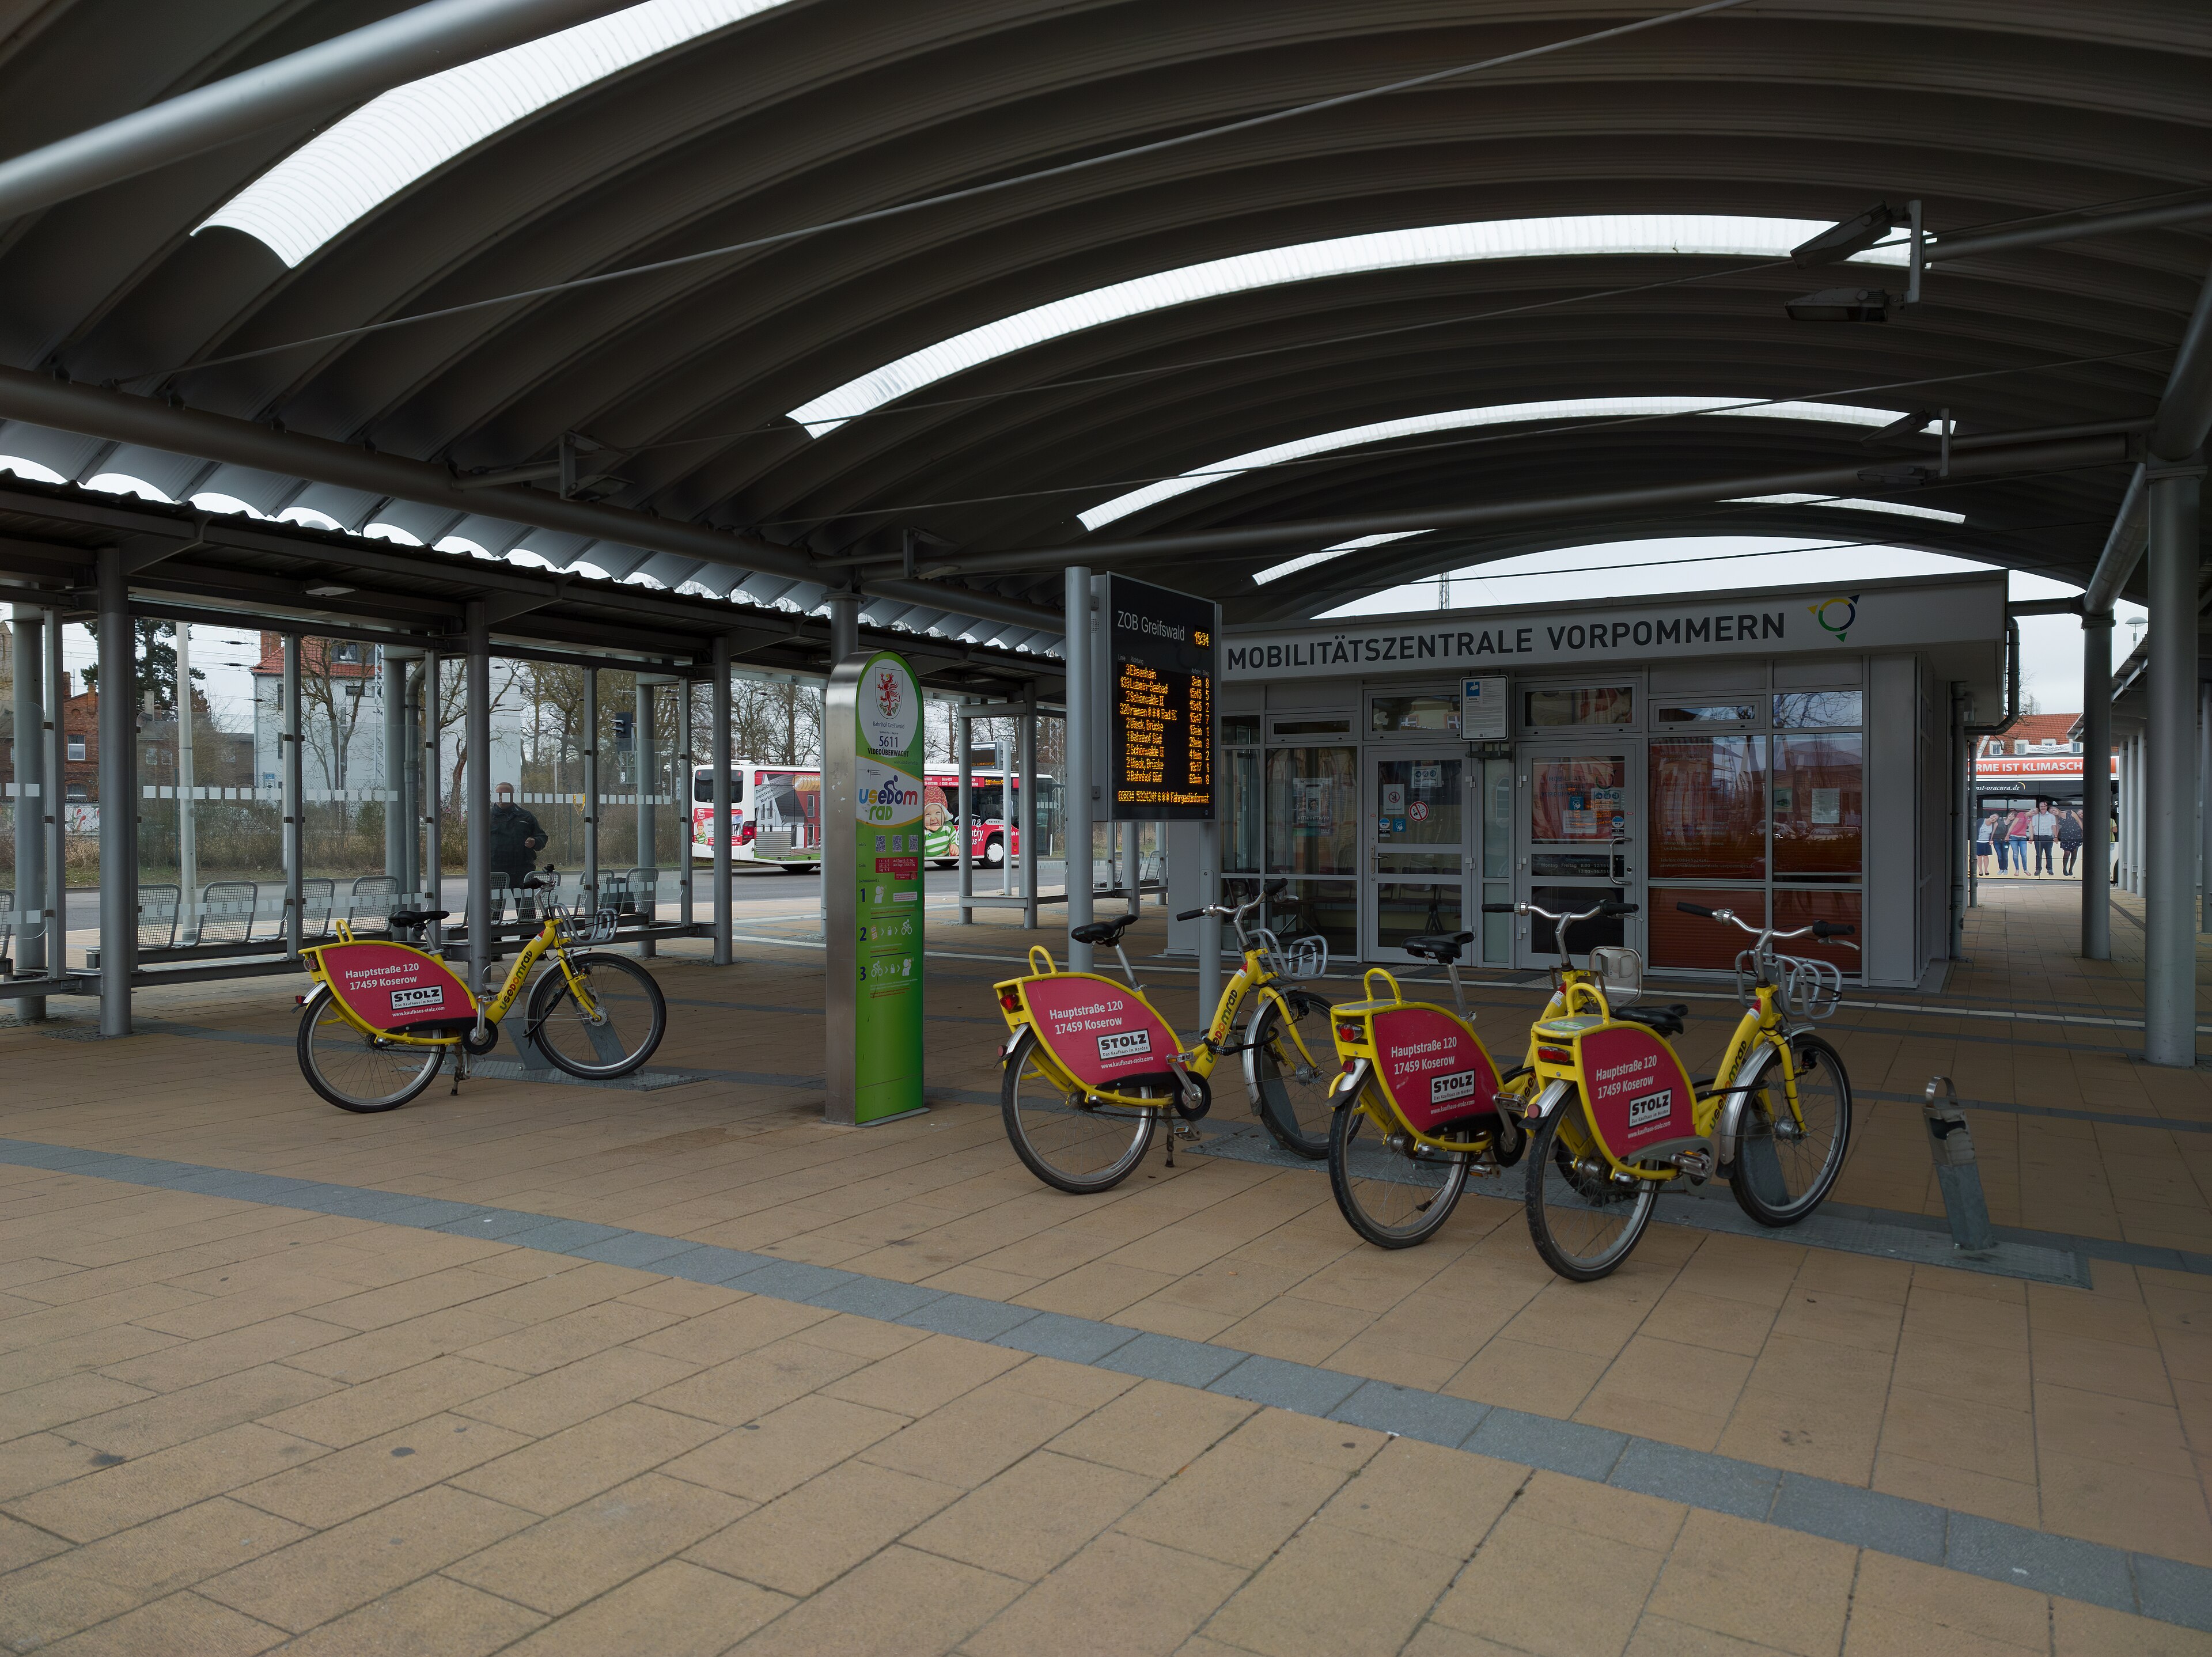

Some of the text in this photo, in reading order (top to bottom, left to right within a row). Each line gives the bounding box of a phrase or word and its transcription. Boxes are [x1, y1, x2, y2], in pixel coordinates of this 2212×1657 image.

[1118, 611, 1184, 641] ZOB Greifswald
[1227, 612, 1785, 671] MOBILITÄTSZENTRALE VORPOMMERN
[1130, 657, 1143, 665] Richtung
[878, 735, 899, 748] 5611
[868, 747, 910, 757] VIDEOÜBERWACHT
[1976, 761, 2082, 772] RME IST KLIMASCH
[860, 888, 865, 903] 1
[859, 927, 867, 942] 2
[345, 963, 419, 979] Hauptstraße 120
[859, 966, 866, 981] 3
[350, 976, 417, 990] 17459 Koserow
[394, 989, 440, 1002] STOLZ
[392, 1006, 445, 1017] www.kaufhaus-stolz.com
[1050, 1000, 1123, 1020] Hauptstraße 120
[1055, 1017, 1122, 1034] 17459 Koserow
[1206, 988, 1237, 1064] uedomrad
[1101, 1034, 1147, 1050] STOLZ
[1391, 1036, 1457, 1058] Hauptstraße 120
[1101, 1056, 1153, 1069] www.kaufhaus-stolz.com
[1395, 1056, 1455, 1075] 17459 Koserow
[1596, 1055, 1657, 1082] Hauptstraße 120
[1433, 1075, 1472, 1093] STOLZ
[1598, 1075, 1654, 1099] 17459 Koserow
[1632, 1094, 1669, 1116] STOLZ
